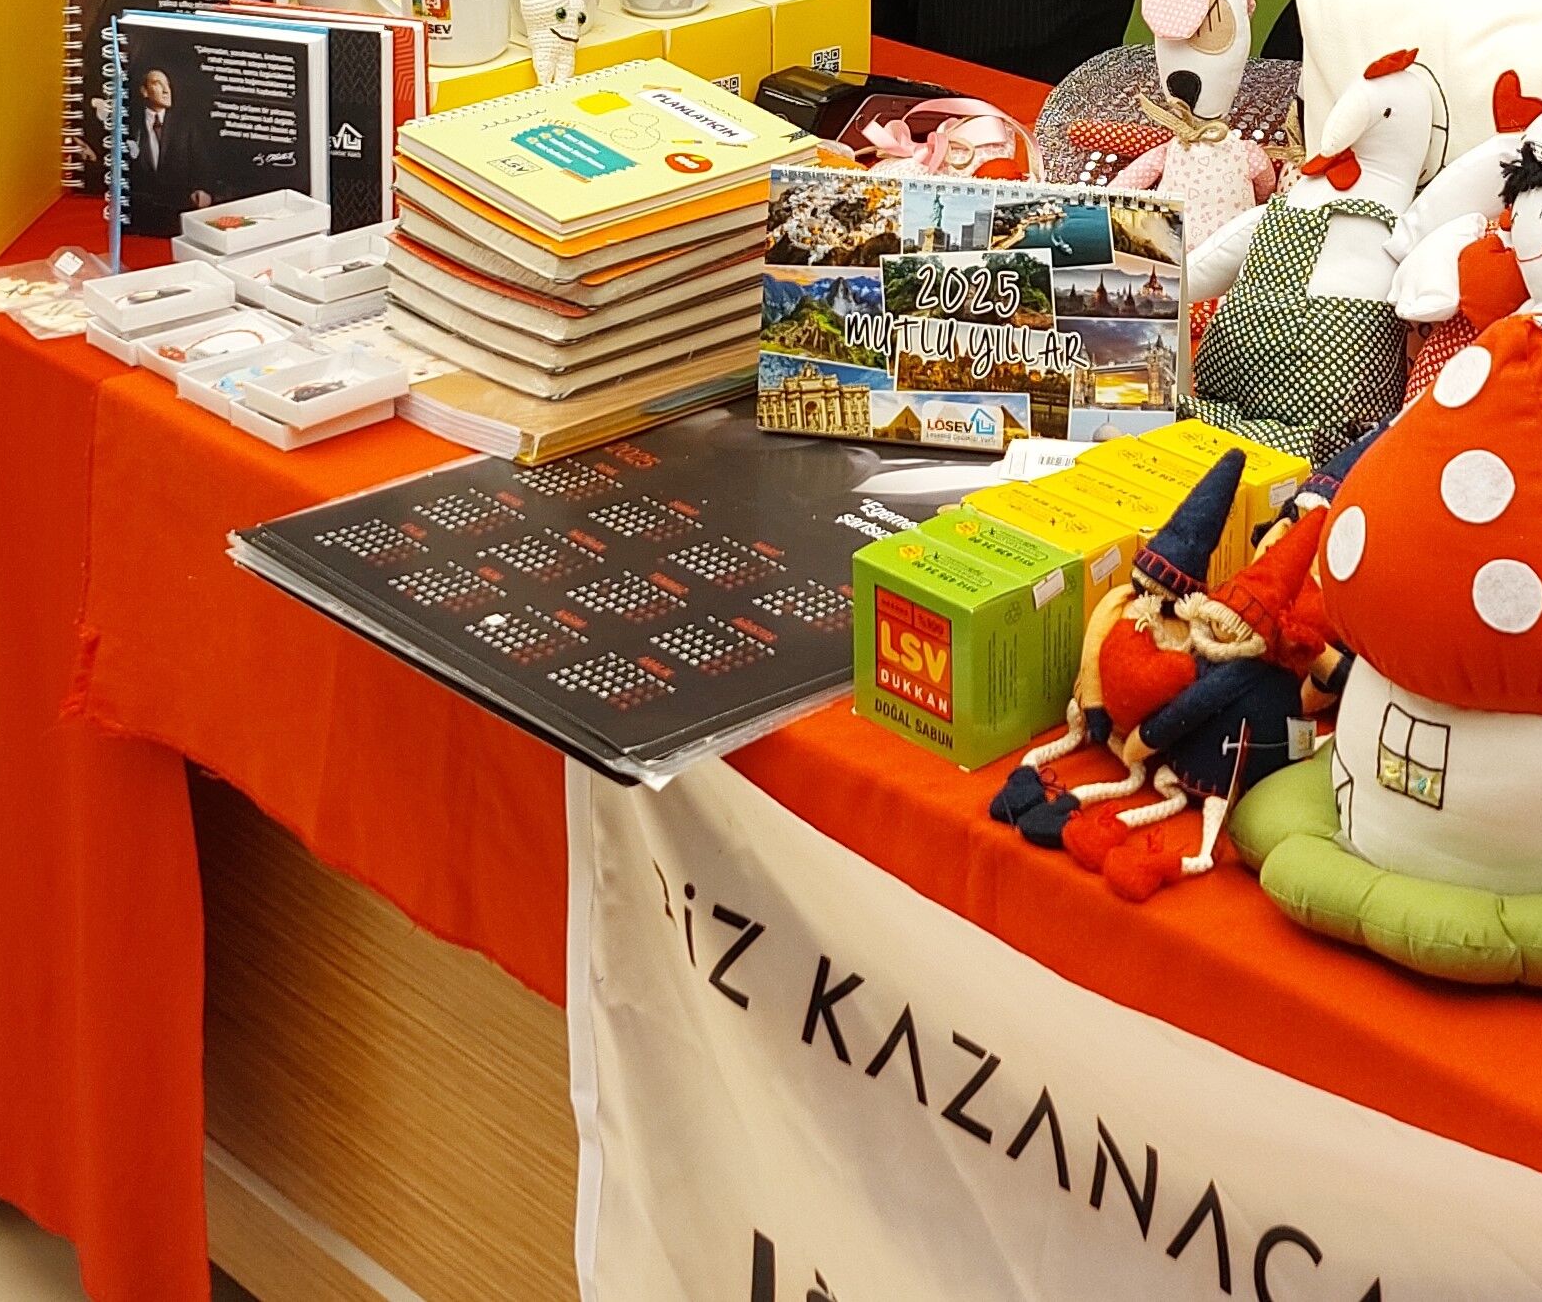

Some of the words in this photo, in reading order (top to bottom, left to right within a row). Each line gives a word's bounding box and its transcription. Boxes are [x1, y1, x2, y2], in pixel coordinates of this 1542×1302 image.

[915, 264, 1021, 318] 2025
[845, 311, 957, 362] MUTLU
[968, 325, 1091, 379] YILLAR
[927, 416, 973, 434] LÖSEV
[880, 619, 948, 683] LSV
[875, 697, 912, 728] DOĞAL
[915, 719, 954, 750] SABUN
[653, 857, 767, 1011] İZ
[801, 953, 1382, 1302] KAZANAC
